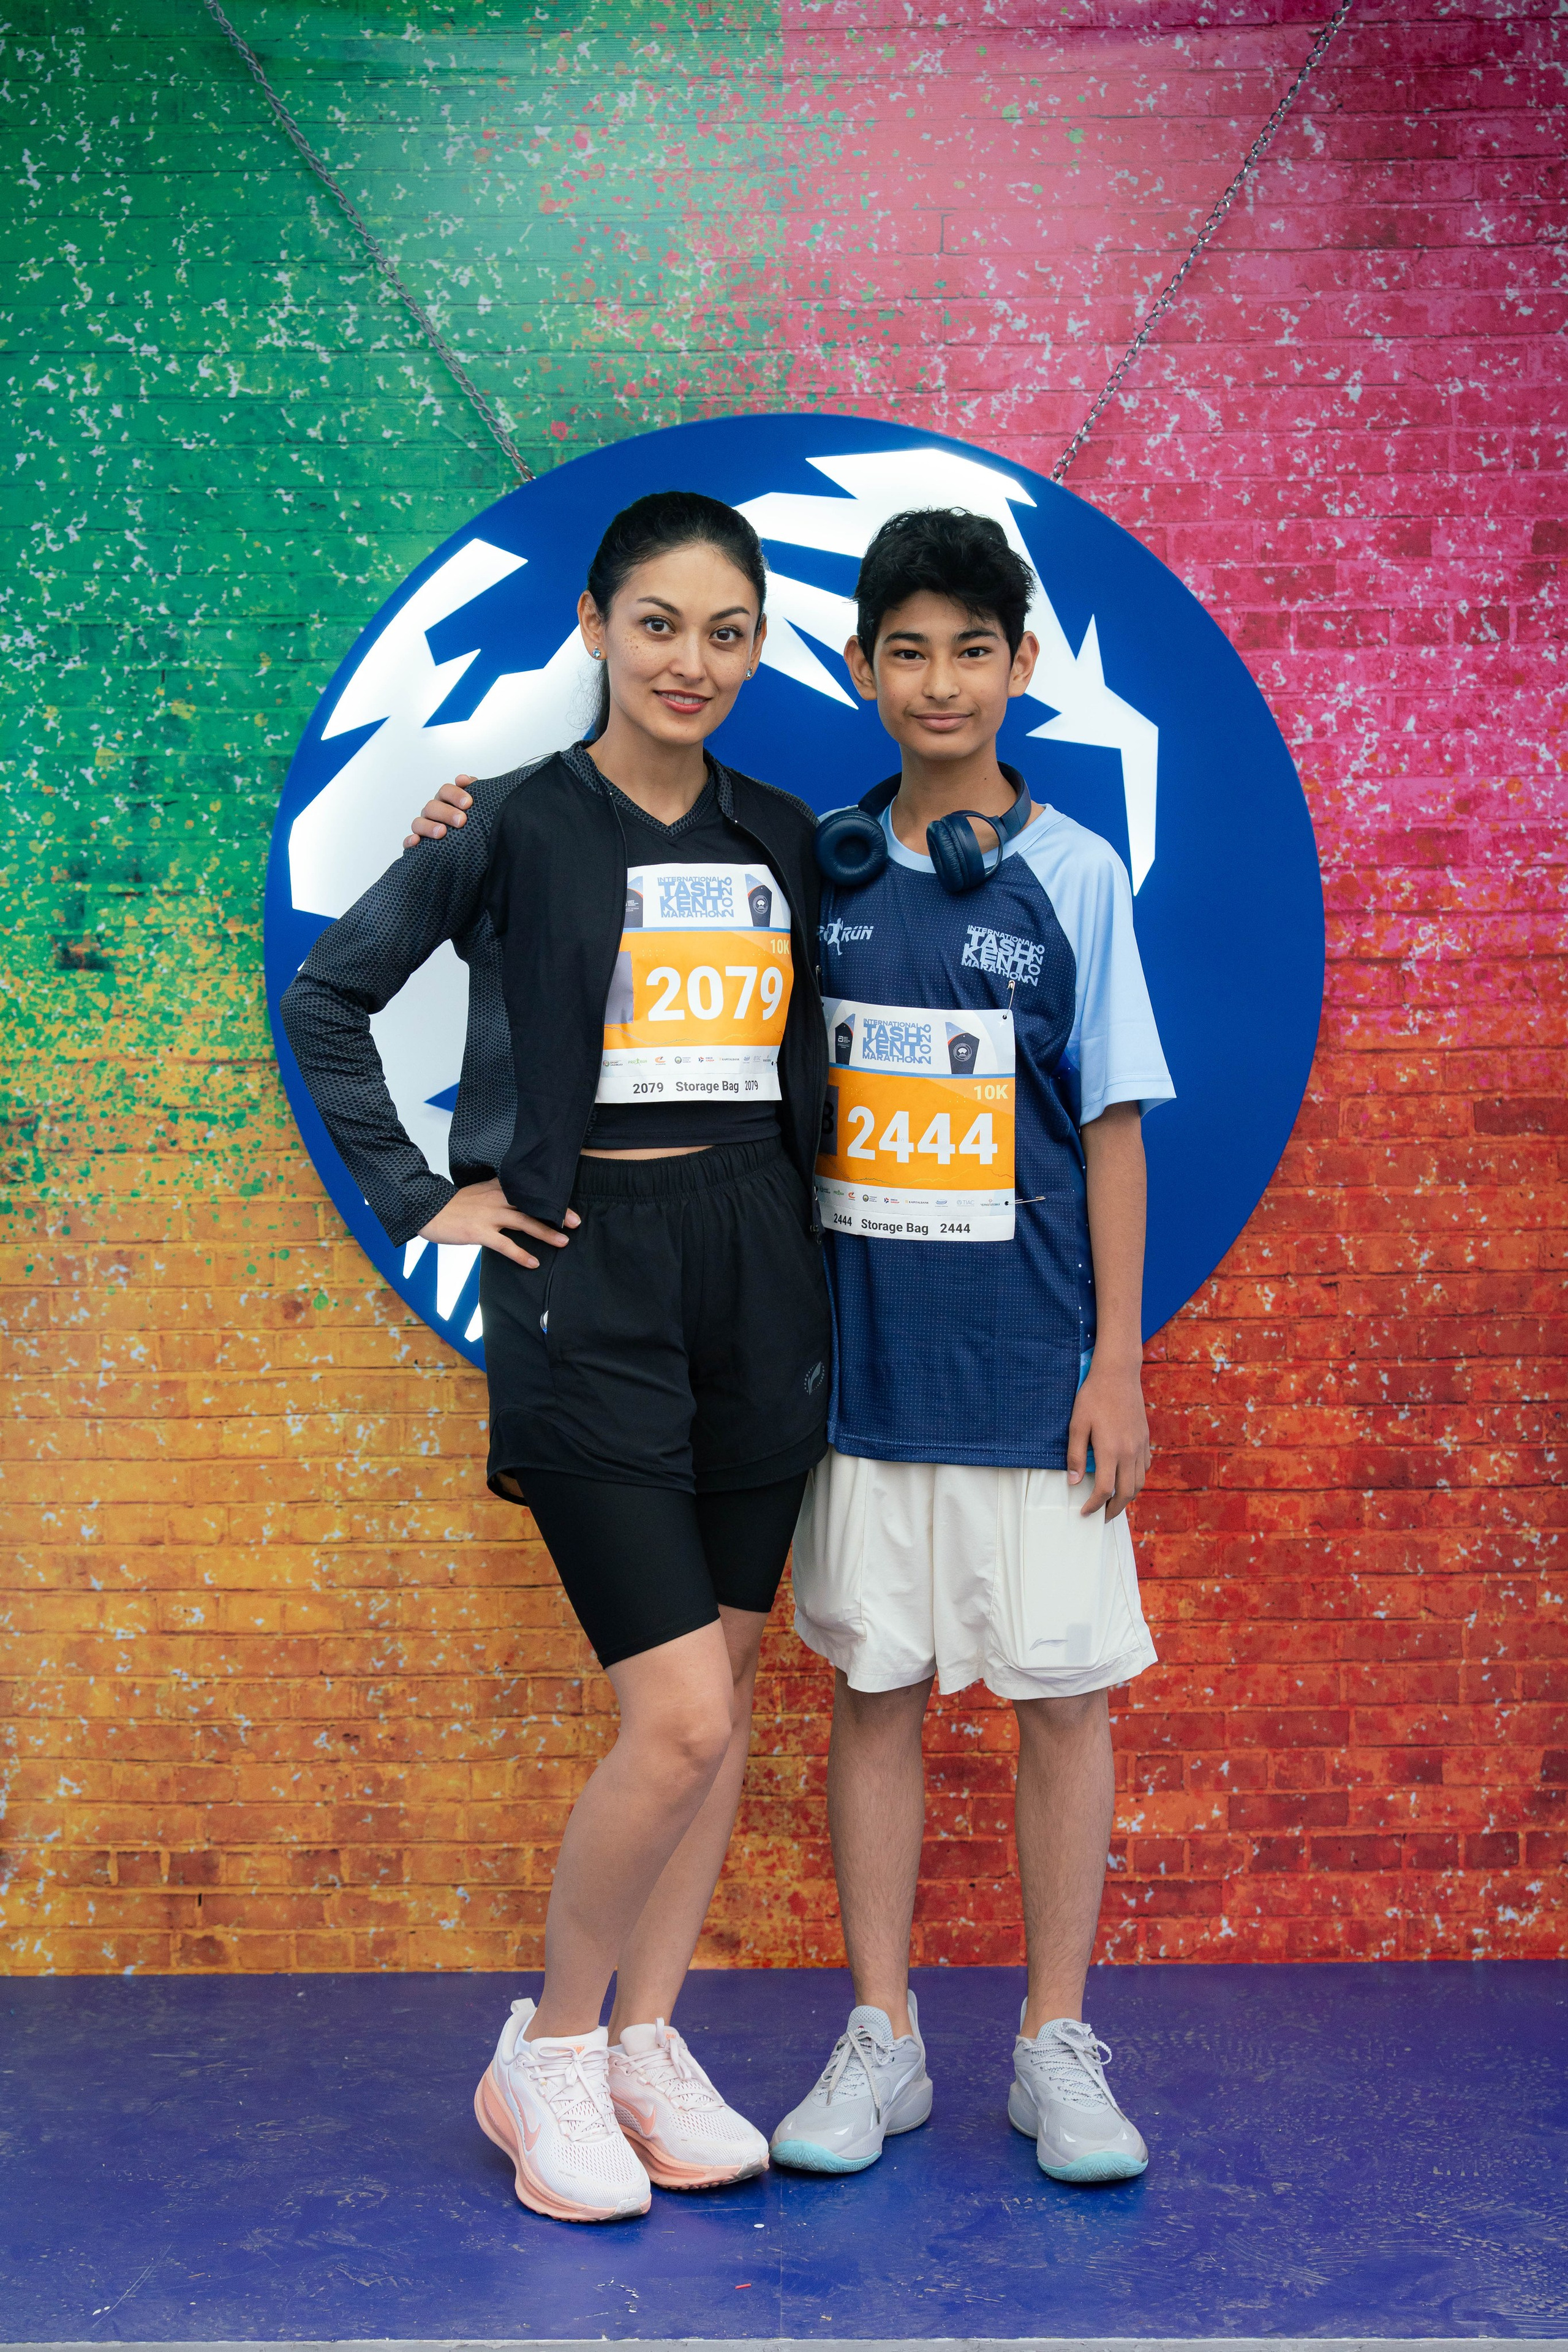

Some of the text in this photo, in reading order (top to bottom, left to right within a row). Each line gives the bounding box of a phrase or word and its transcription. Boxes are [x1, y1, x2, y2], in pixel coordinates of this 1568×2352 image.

[658, 881, 722, 899] TASH
[722, 876, 734, 918] 2026
[660, 896, 722, 911] KENT
[840, 925, 874, 942] RUN
[968, 925, 1033, 947] INTERNATIONAL
[770, 938, 790, 955] 10K
[967, 930, 1034, 965] TASH
[962, 943, 1031, 974] KENT
[1027, 944, 1045, 987] 2026
[961, 957, 1027, 983] MARATHON
[646, 965, 783, 1022] 2079
[863, 1018, 920, 1028] INTERNATIONAL
[863, 1023, 921, 1046] TASH
[919, 1023, 931, 1065] 2026
[862, 1037, 921, 1057] KENT
[862, 1052, 921, 1064] MARATHON
[633, 1080, 758, 1094] 2079 Storage Bag 2079
[973, 1084, 1009, 1101] 10K
[847, 1106, 998, 1165] 2444
[834, 1213, 971, 1235] 2444 Storage Bag 2444
